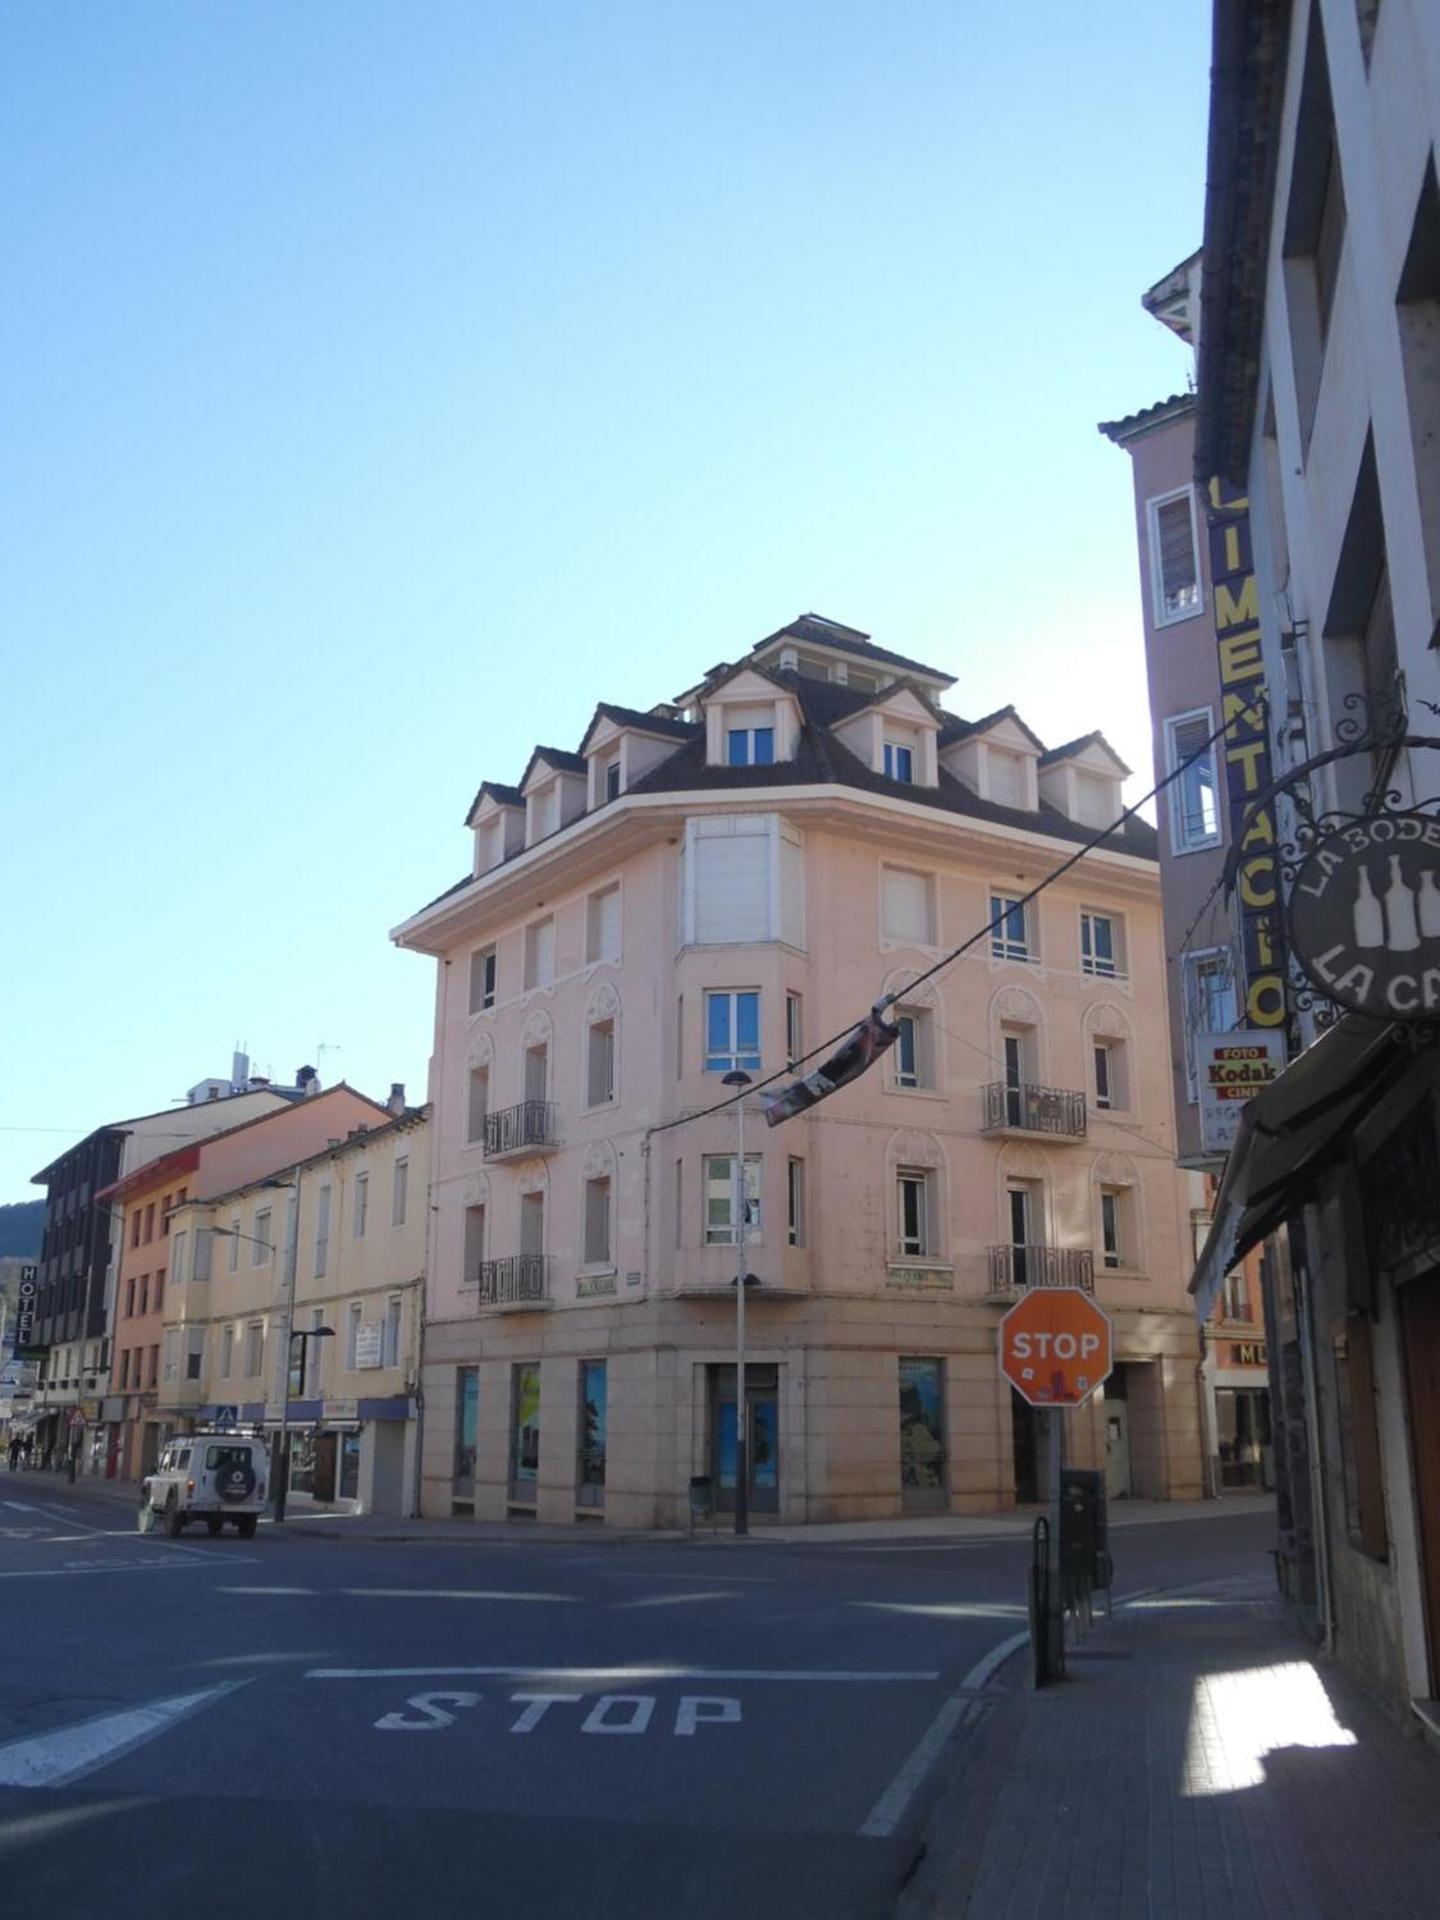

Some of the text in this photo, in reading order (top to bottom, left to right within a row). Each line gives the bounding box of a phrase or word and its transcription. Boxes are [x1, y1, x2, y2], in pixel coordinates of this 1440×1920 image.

[1301, 849, 1344, 897] LA
[1311, 944, 1375, 1004] LA
[1208, 1063, 1277, 1084] Kodak
[1223, 1048, 1259, 1058] FOTO
[17, 1266, 35, 1344] HOTEL
[1011, 1332, 1100, 1359] STOP
[373, 1691, 743, 1736] STOP
